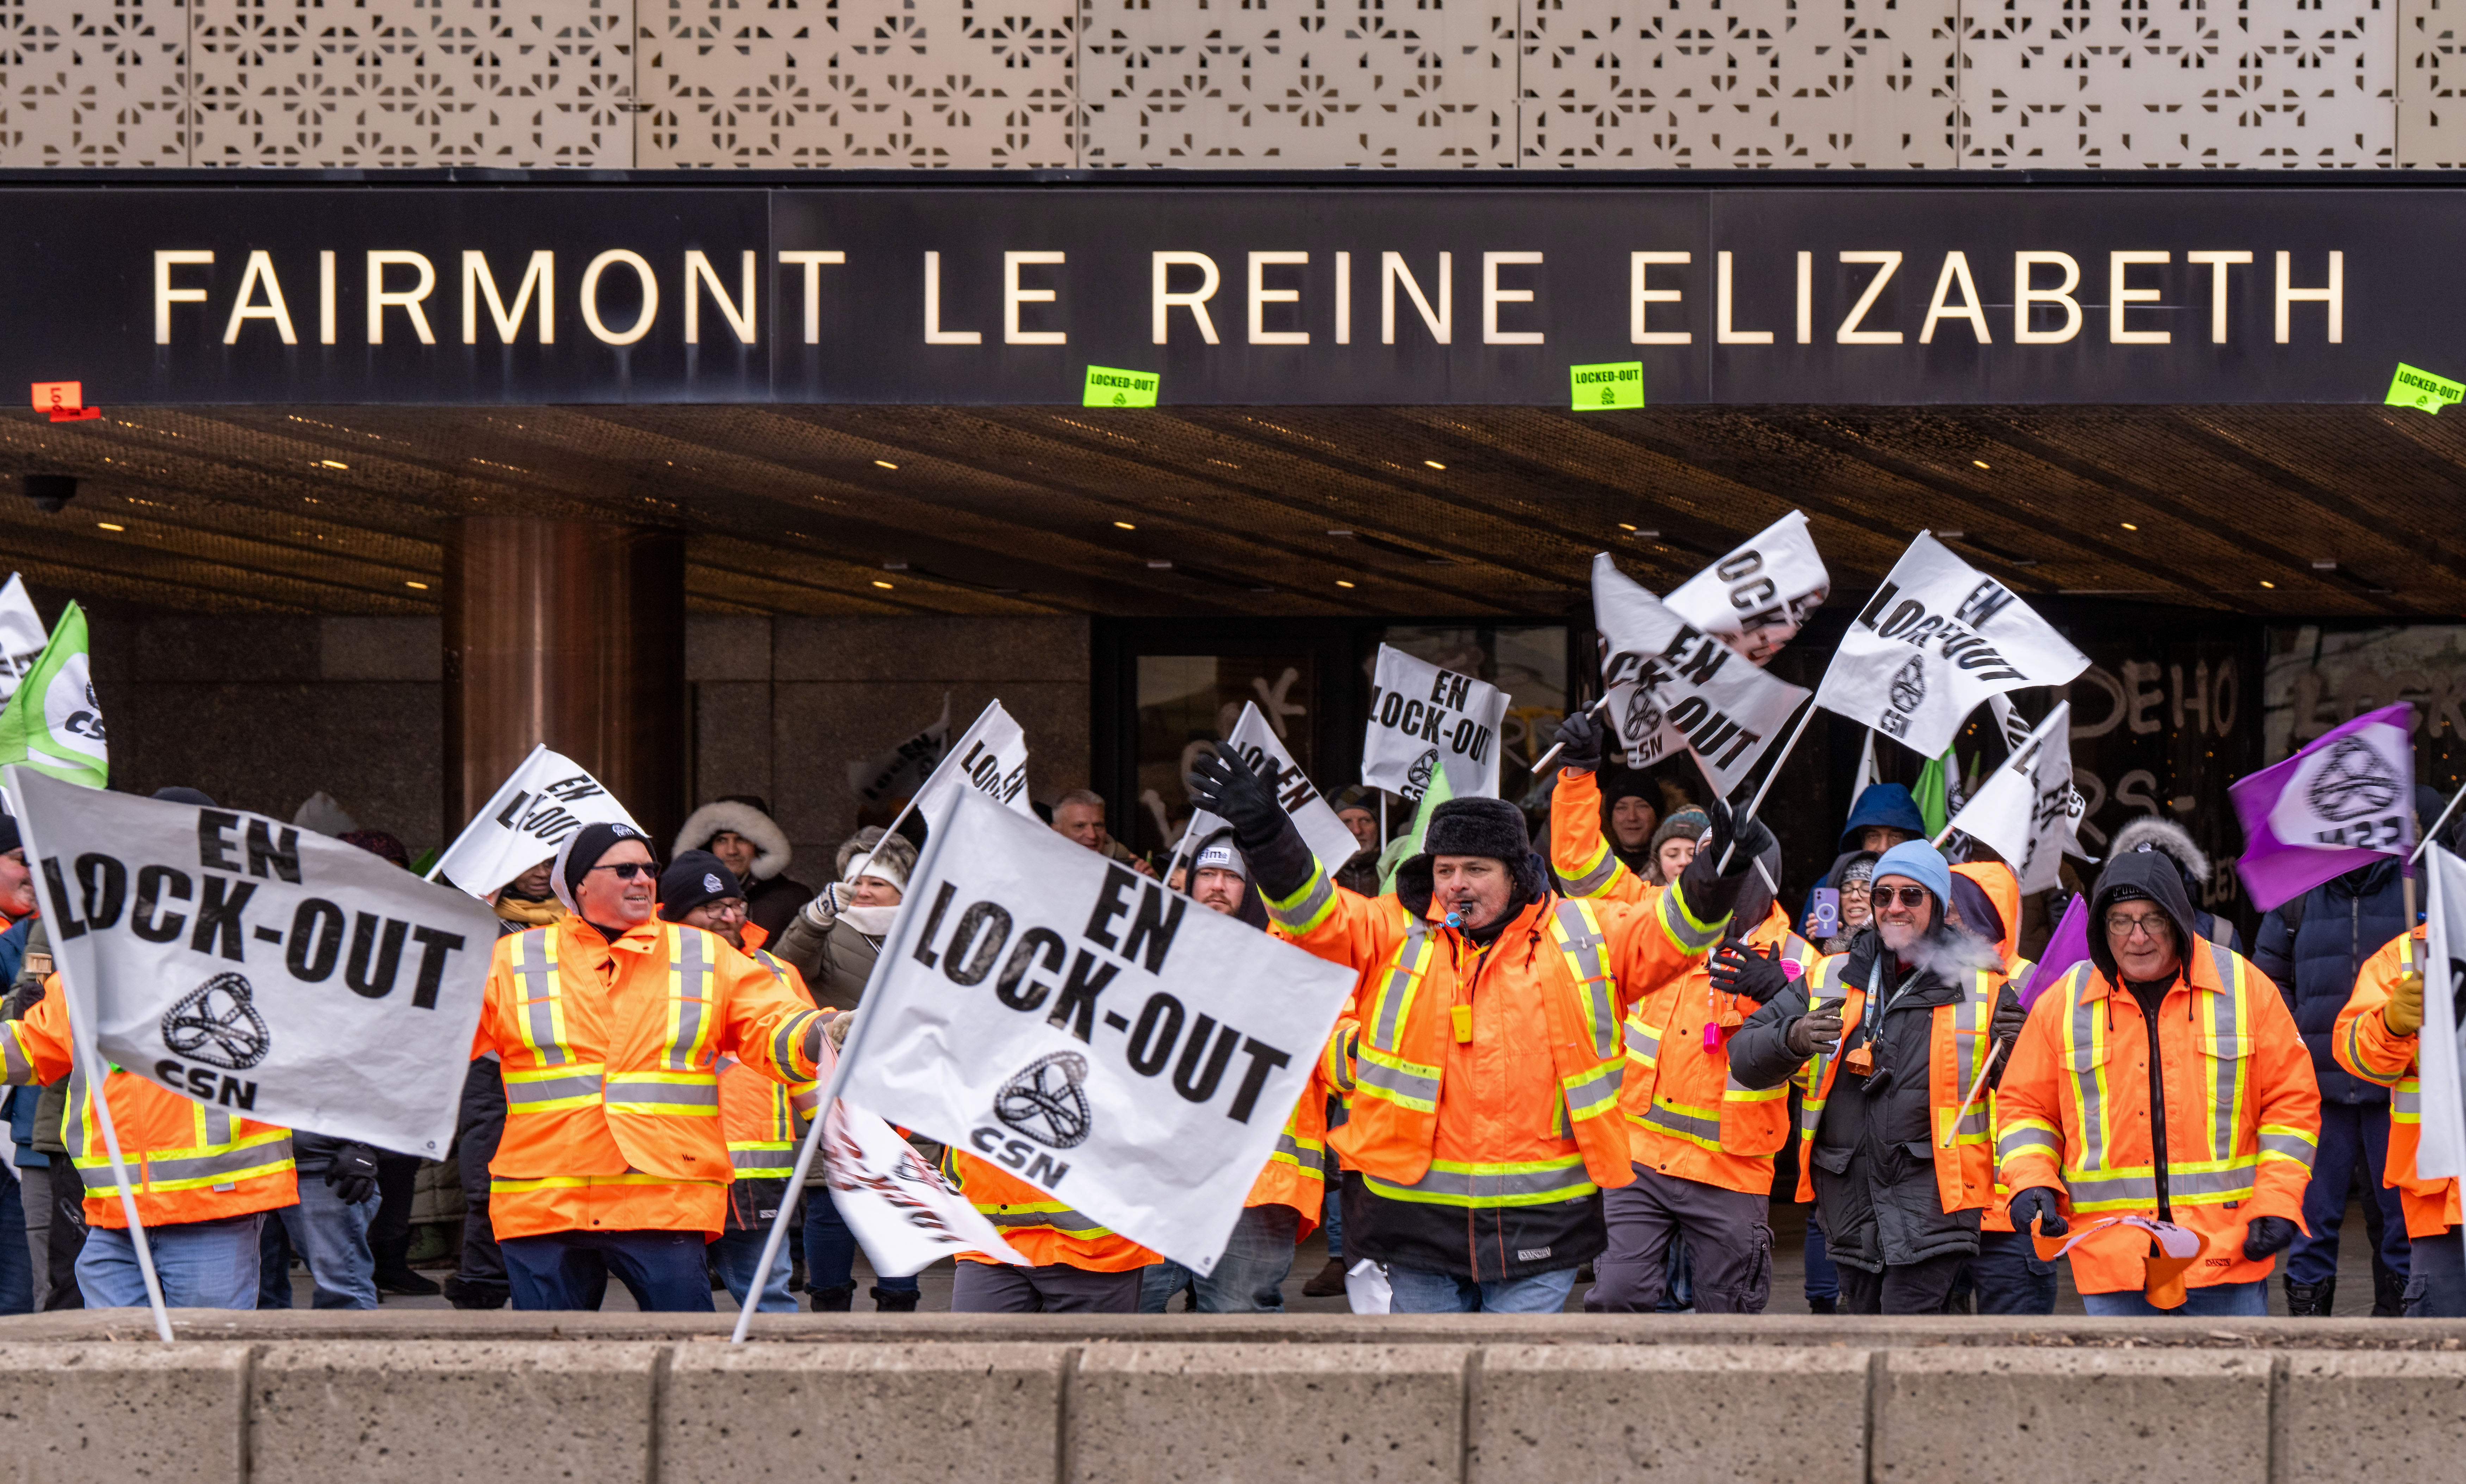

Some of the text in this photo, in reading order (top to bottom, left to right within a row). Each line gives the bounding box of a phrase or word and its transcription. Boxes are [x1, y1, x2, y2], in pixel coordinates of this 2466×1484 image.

[154, 249, 2343, 345] FAIRMONT LE REINE ELIZABETH
[1091, 373, 1155, 392] LOCKED-OUT
[1575, 369, 1640, 384] LOCKED-OUT
[2398, 371, 2461, 401] LOCKED-OUT
[1658, 624, 1733, 687] EN
[1430, 669, 1472, 713] EN
[64, 710, 106, 741] CS
[544, 774, 605, 803] EN
[1276, 764, 1319, 815] EN
[1400, 784, 1425, 802] CS
[197, 808, 302, 885] EN
[42, 852, 466, 1010] LOCK-OUT
[1083, 863, 1188, 976] EN
[912, 880, 1292, 1125] LOCK-OUT
[154, 1059, 258, 1112] CSN
[969, 1127, 1071, 1189] CSN
